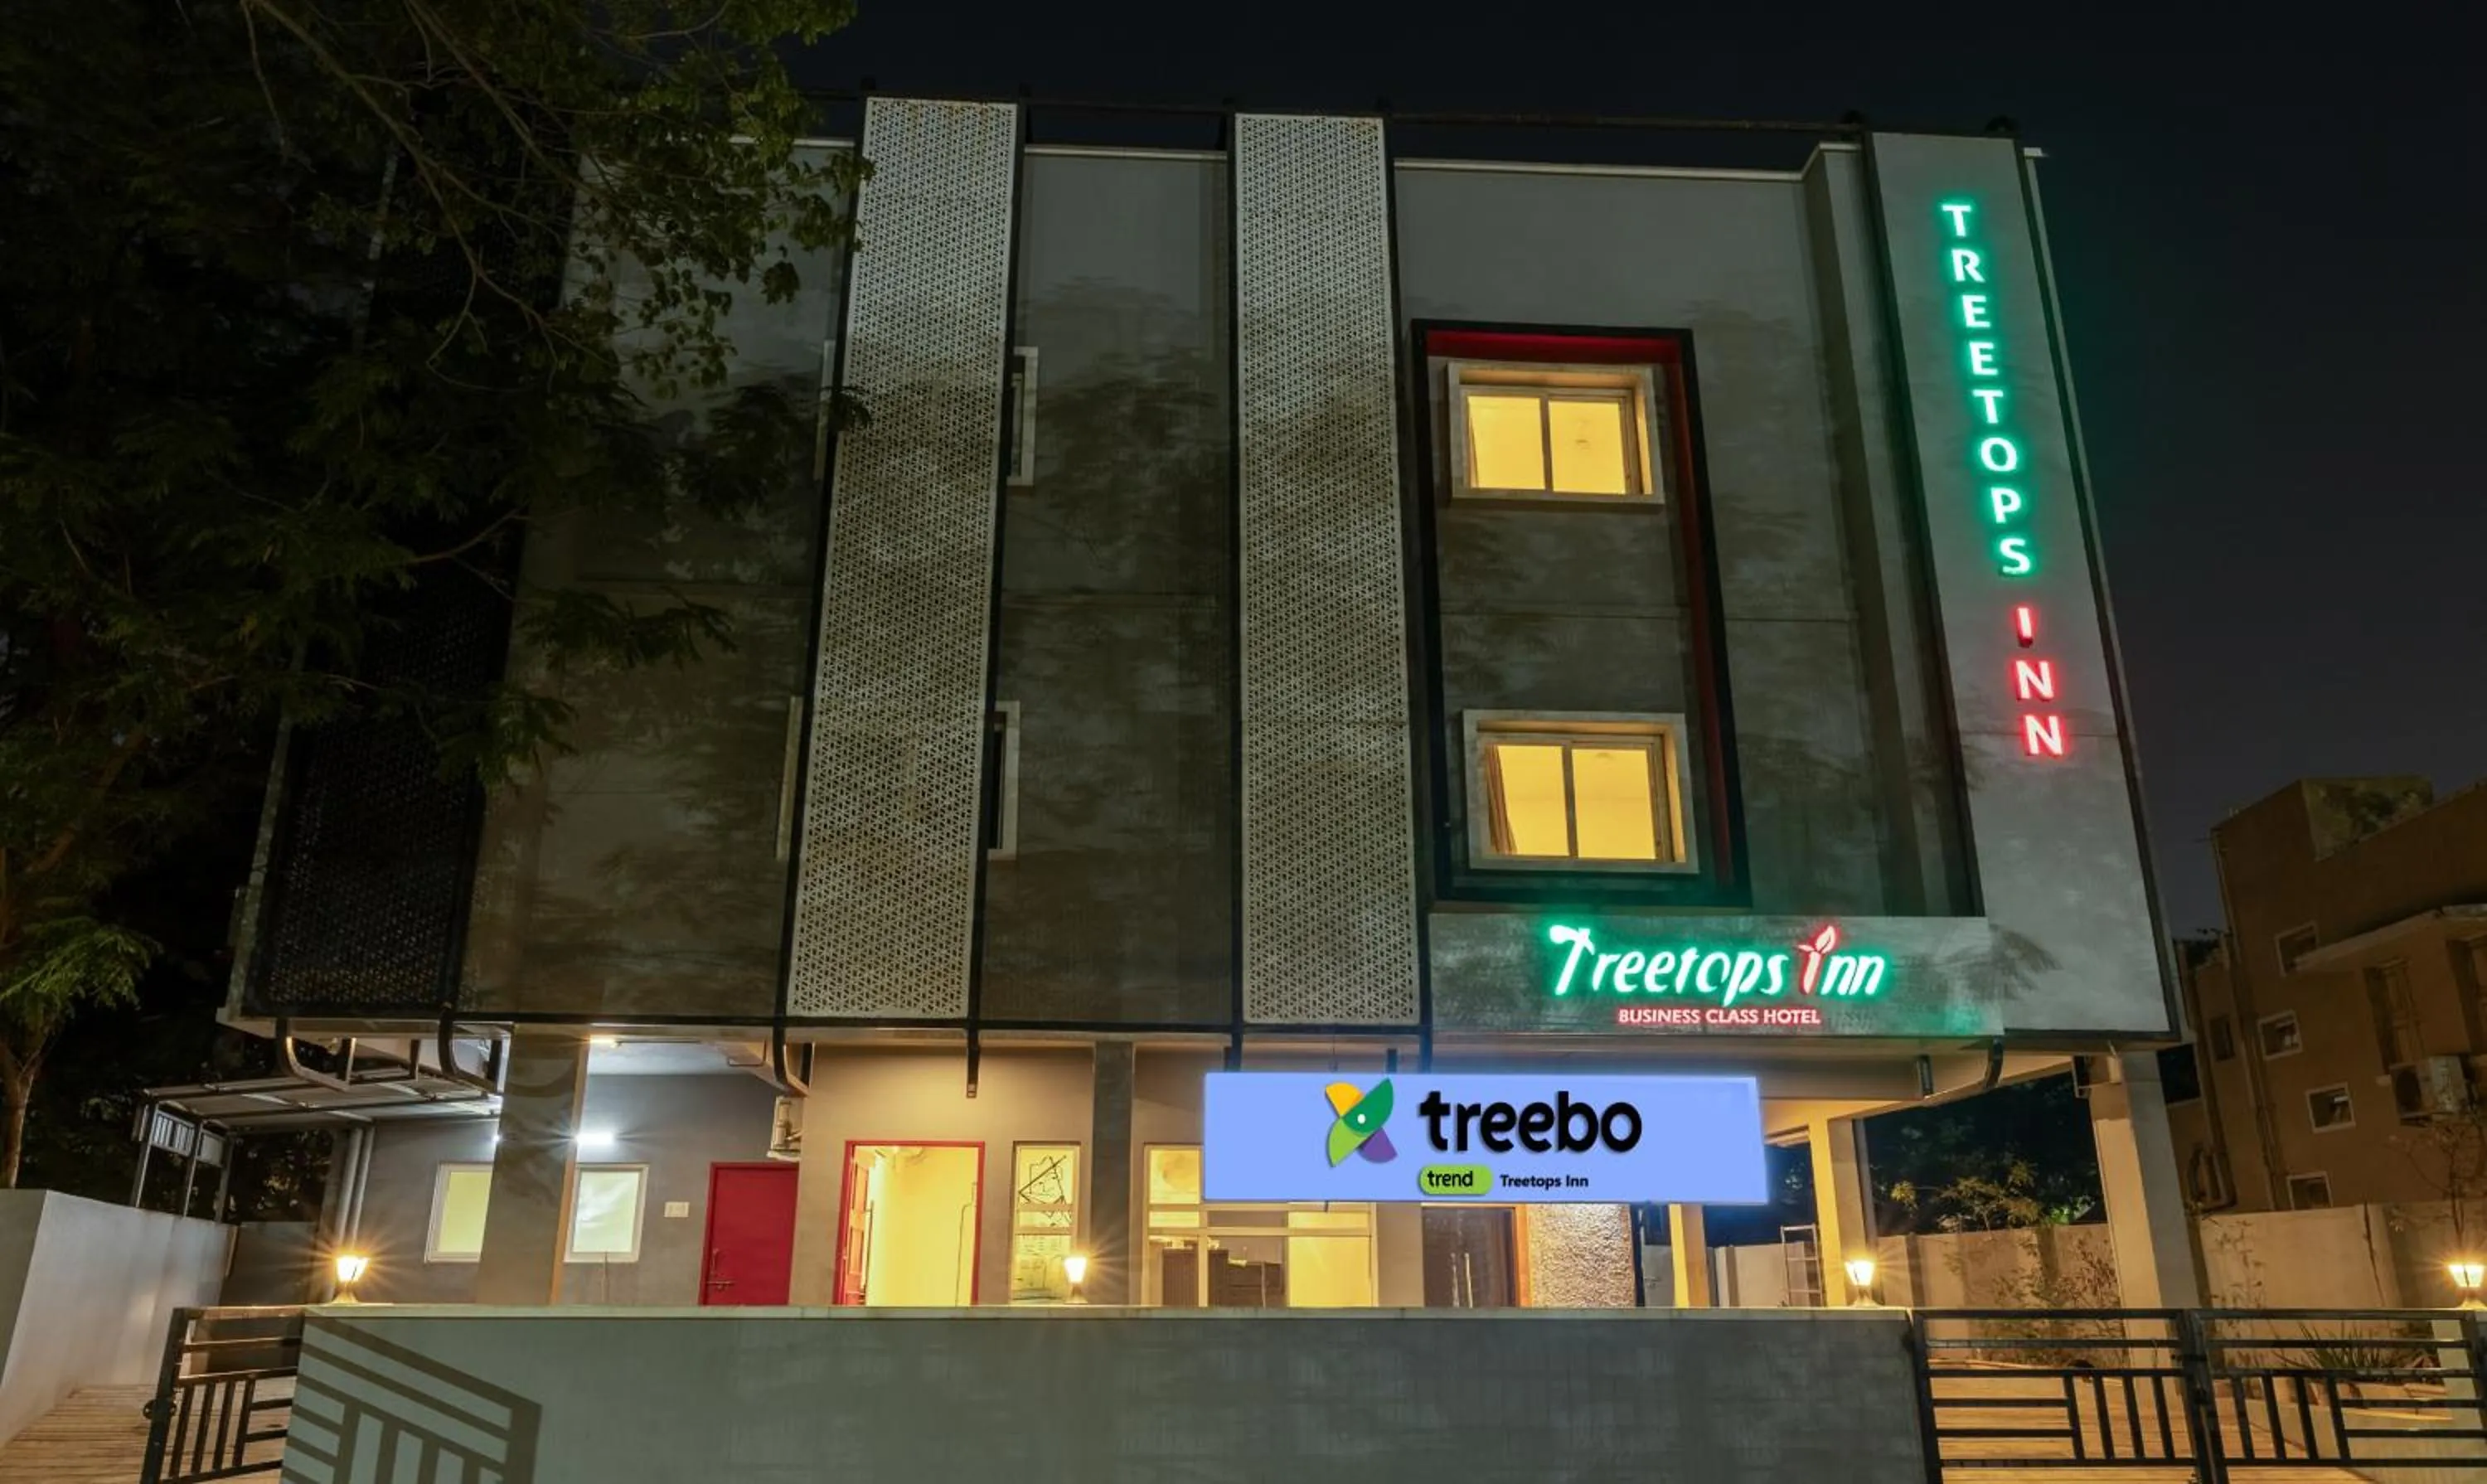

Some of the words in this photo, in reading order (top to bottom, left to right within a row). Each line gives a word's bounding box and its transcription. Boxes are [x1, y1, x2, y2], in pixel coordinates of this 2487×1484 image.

[1942, 204, 2032, 575] TREETOPS
[2015, 607, 2063, 755] INN
[1549, 924, 1789, 1006] Treetops
[1618, 1009, 1700, 1024] BUSINESS
[1705, 1009, 1758, 1024] CLASS
[1763, 1009, 1820, 1024] HOTEL
[1418, 1090, 1642, 1153] treebo
[1427, 1171, 1473, 1188] trend
[1500, 1174, 1562, 1190] Treetops
[1565, 1175, 1589, 1187] Inn
